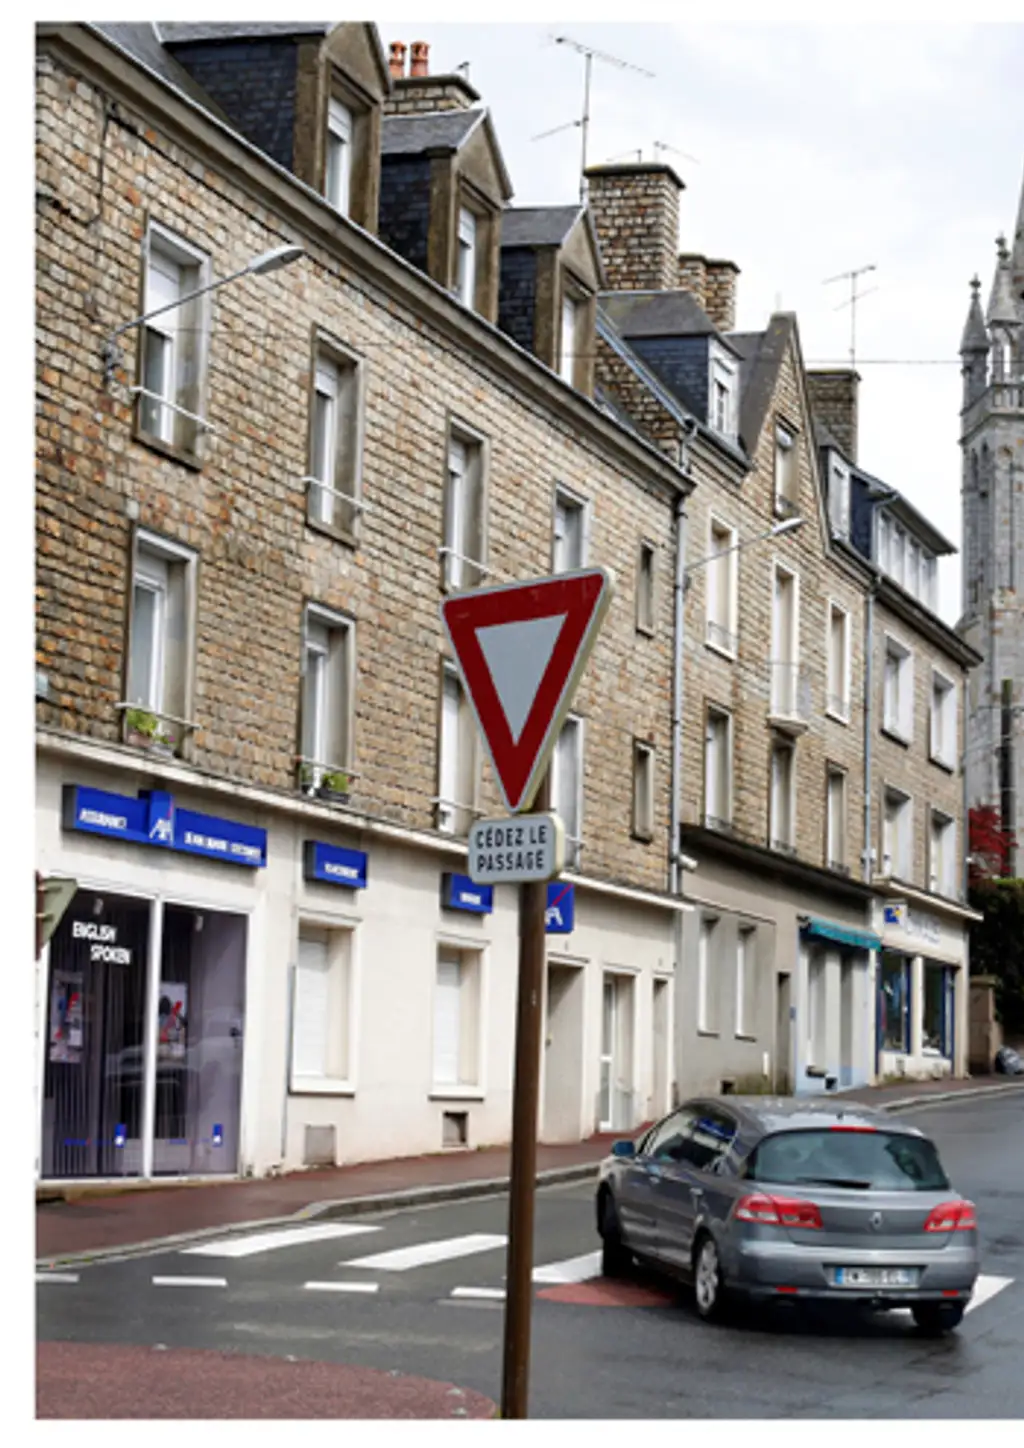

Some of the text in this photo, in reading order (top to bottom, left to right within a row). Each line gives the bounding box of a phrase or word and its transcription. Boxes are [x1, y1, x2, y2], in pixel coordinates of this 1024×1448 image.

[475, 825, 547, 849] CÉDEZ LE
[477, 850, 544, 872] PASSAGE
[73, 920, 117, 943] ENGLISH
[91, 944, 131, 965] SPOKEN
